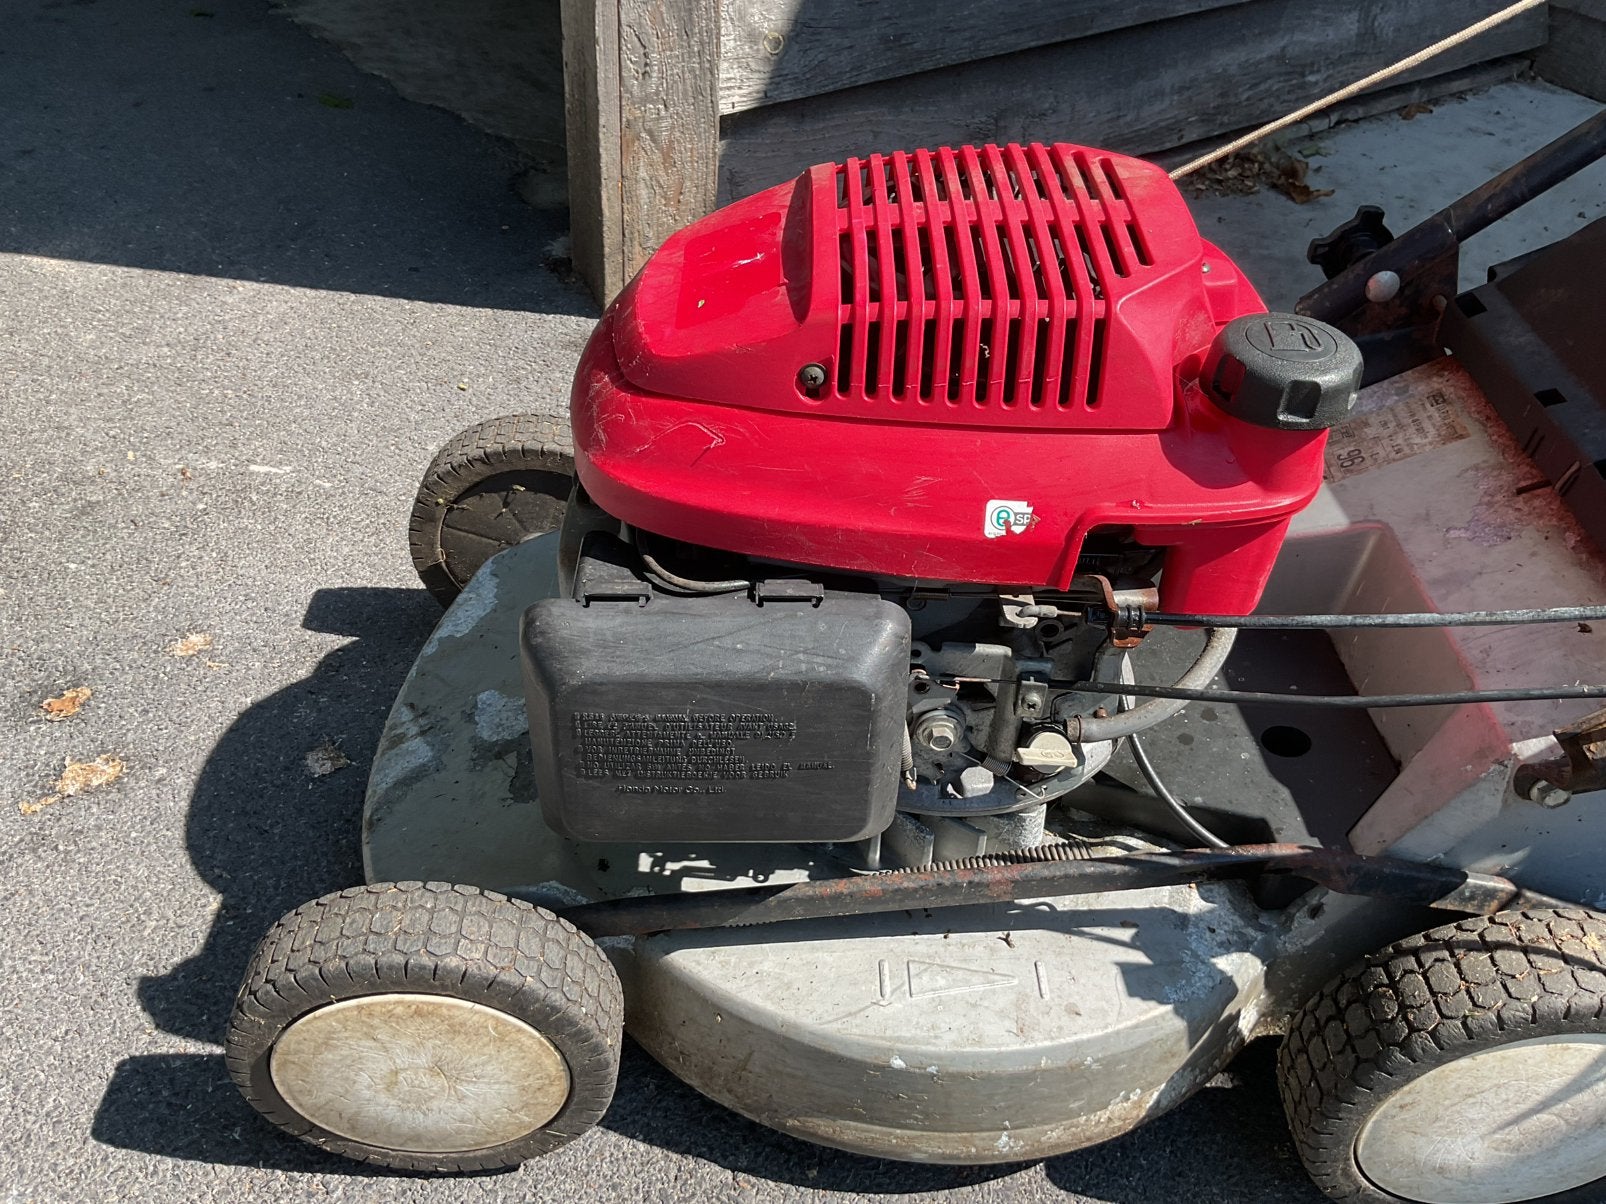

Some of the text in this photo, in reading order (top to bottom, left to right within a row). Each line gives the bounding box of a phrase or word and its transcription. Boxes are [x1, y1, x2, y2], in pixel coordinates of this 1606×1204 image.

[1336, 448, 1366, 469] 96
[693, 713, 726, 722] BEFORE
[729, 713, 778, 722] OPERATION.
[623, 722, 659, 731] MANUEL
[737, 722, 764, 731] AVANT
[584, 729, 620, 738] LEGGERE
[626, 730, 691, 739] ATTENTAMENTE
[585, 738, 653, 747] MANUTENZIONE
[658, 739, 686, 747] PRIMA
[585, 745, 736, 756] VOR INBETRIEBNAHME UNBEDINGT
[586, 753, 688, 763] BEDIENUNGSANLEITUNG
[604, 762, 642, 770] UTILIZAR
[717, 763, 746, 771] HABER
[782, 762, 793, 770] EL
[588, 768, 610, 777] LEES
[637, 770, 719, 779] INSTRUKTIEBOEKJE
[723, 770, 748, 779] VOOR
[752, 770, 789, 779] GEBRUIK
[617, 784, 651, 793] Honda
[654, 785, 683, 793] Motor
